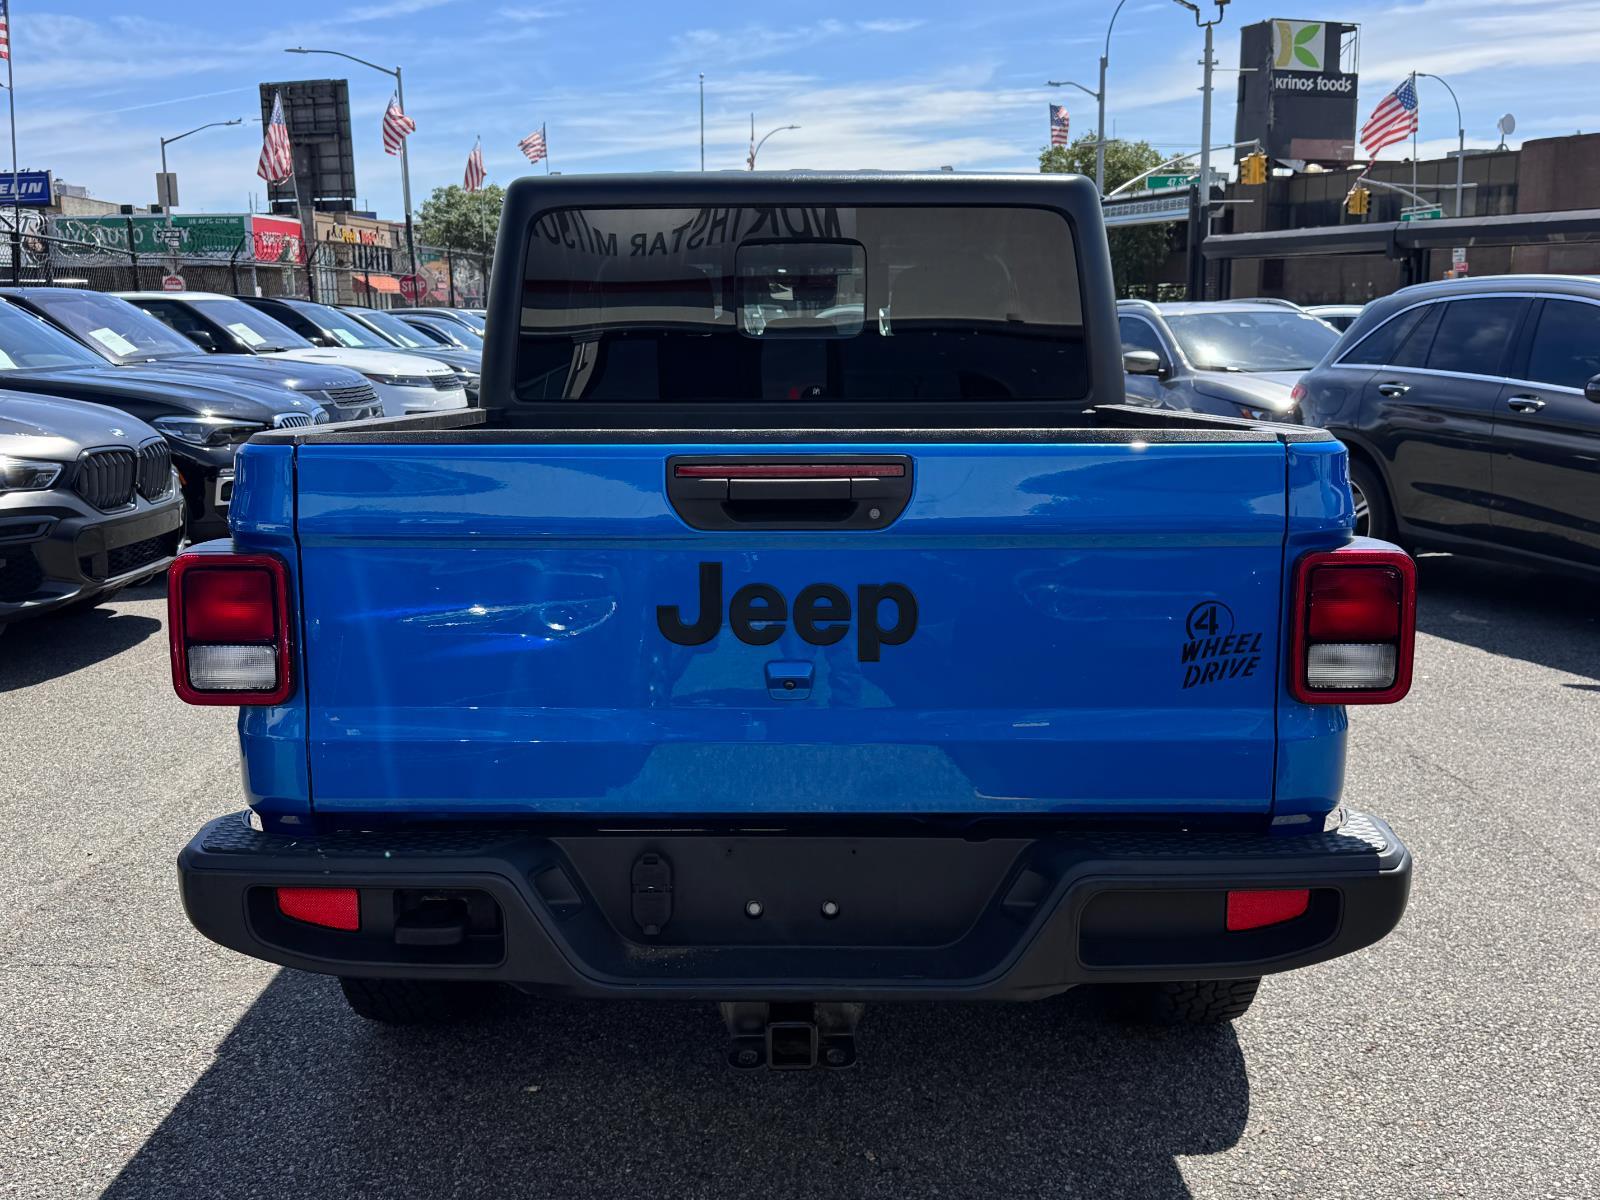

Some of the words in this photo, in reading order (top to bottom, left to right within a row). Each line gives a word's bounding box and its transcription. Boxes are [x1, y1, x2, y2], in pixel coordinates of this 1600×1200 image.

[1316, 76, 1352, 92] foods
[1167, 177, 1177, 188] 47
[401, 280, 426, 293] STOP
[656, 561, 919, 662] Jeep
[1193, 606, 1219, 635] 4
[1181, 632, 1263, 665] WHEEL
[1182, 656, 1262, 690] DRIVE
